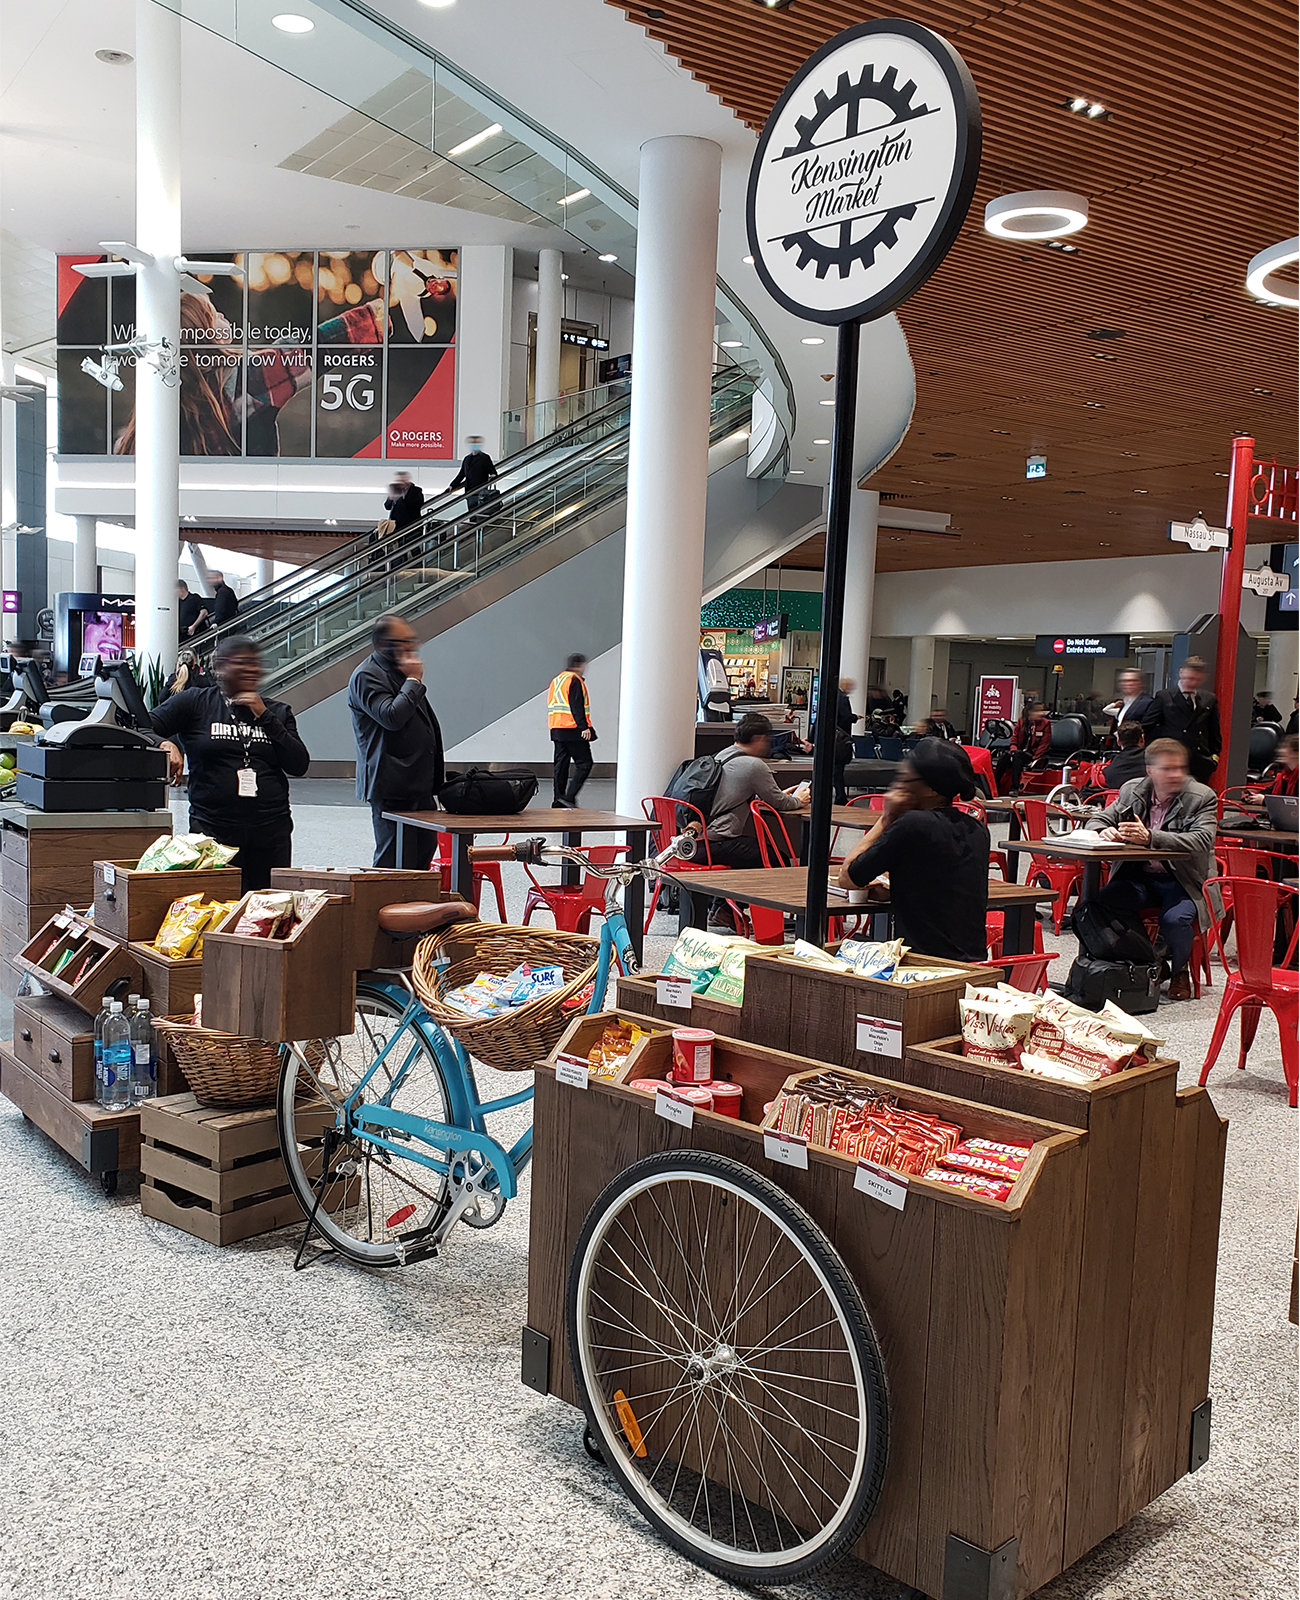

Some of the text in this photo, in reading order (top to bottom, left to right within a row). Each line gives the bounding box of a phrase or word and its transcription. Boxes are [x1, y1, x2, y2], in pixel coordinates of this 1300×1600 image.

[791, 128, 912, 194] Kensington
[805, 175, 882, 223] Market
[178, 322, 261, 344] mpossible
[264, 322, 311, 344] today,
[196, 354, 276, 367] tomorrow
[280, 353, 313, 367] with
[324, 355, 376, 367] ROGERS
[320, 373, 375, 411] 5G
[402, 431, 442, 442] ROGERS
[1184, 526, 1215, 541] Nassau St
[1248, 573, 1274, 588] Augusta
[531, 970, 555, 984] SURF
[867, 1179, 893, 1196] SKITTLES
